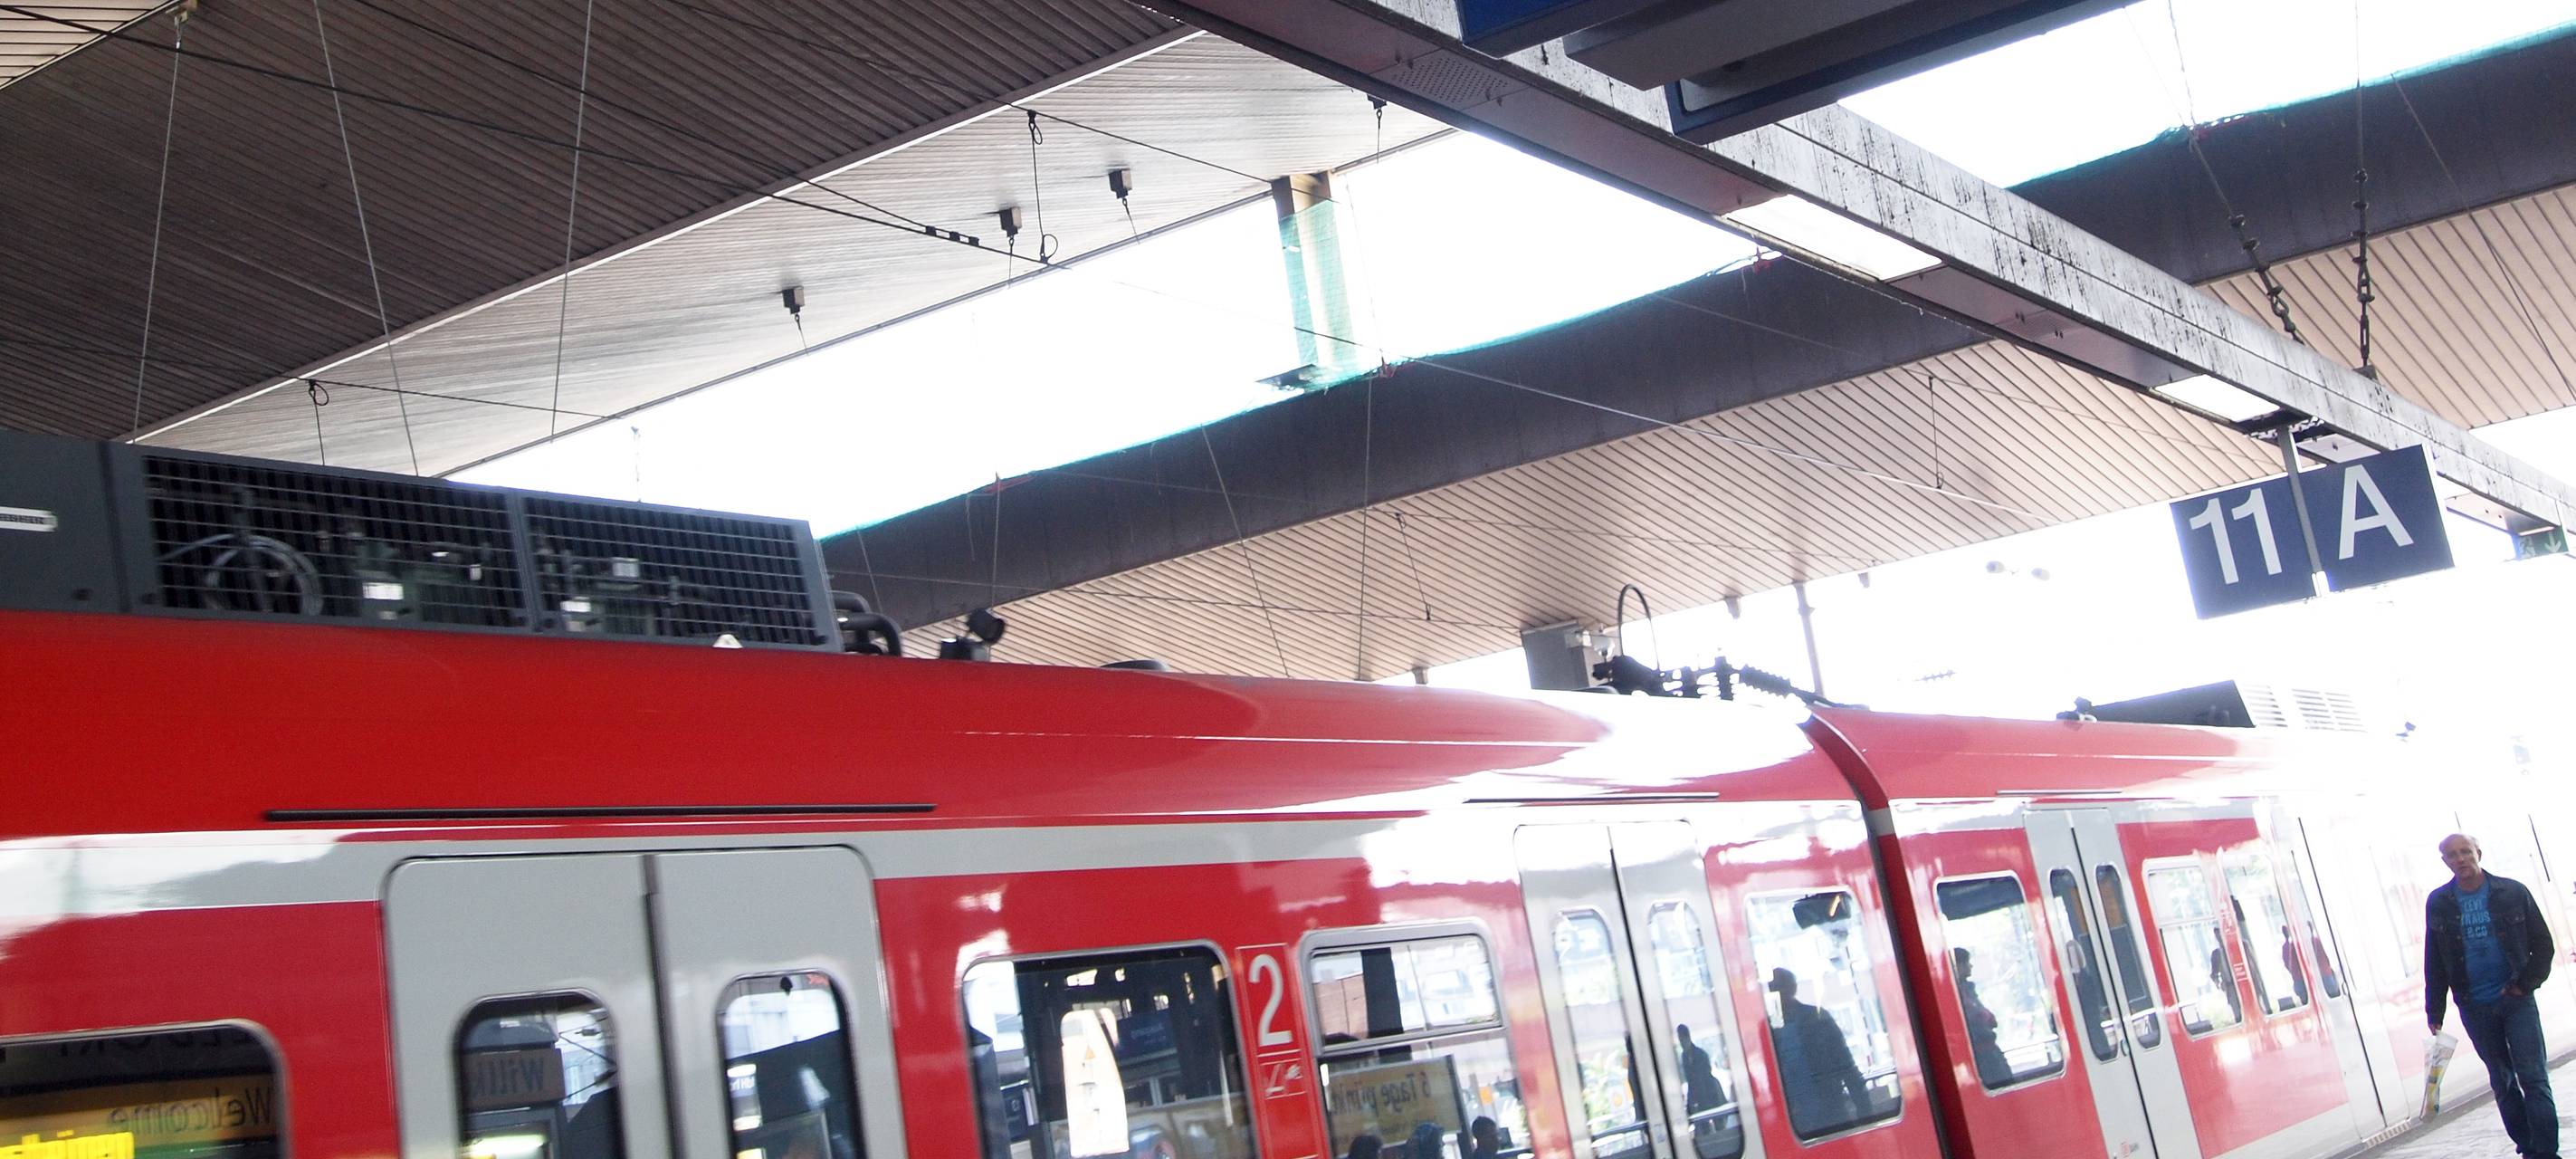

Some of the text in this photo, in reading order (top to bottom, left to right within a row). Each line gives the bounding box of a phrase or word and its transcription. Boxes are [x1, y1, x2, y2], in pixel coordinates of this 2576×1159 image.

[2189, 464, 2414, 584] 11 A
[1248, 953, 1293, 1047] 2
